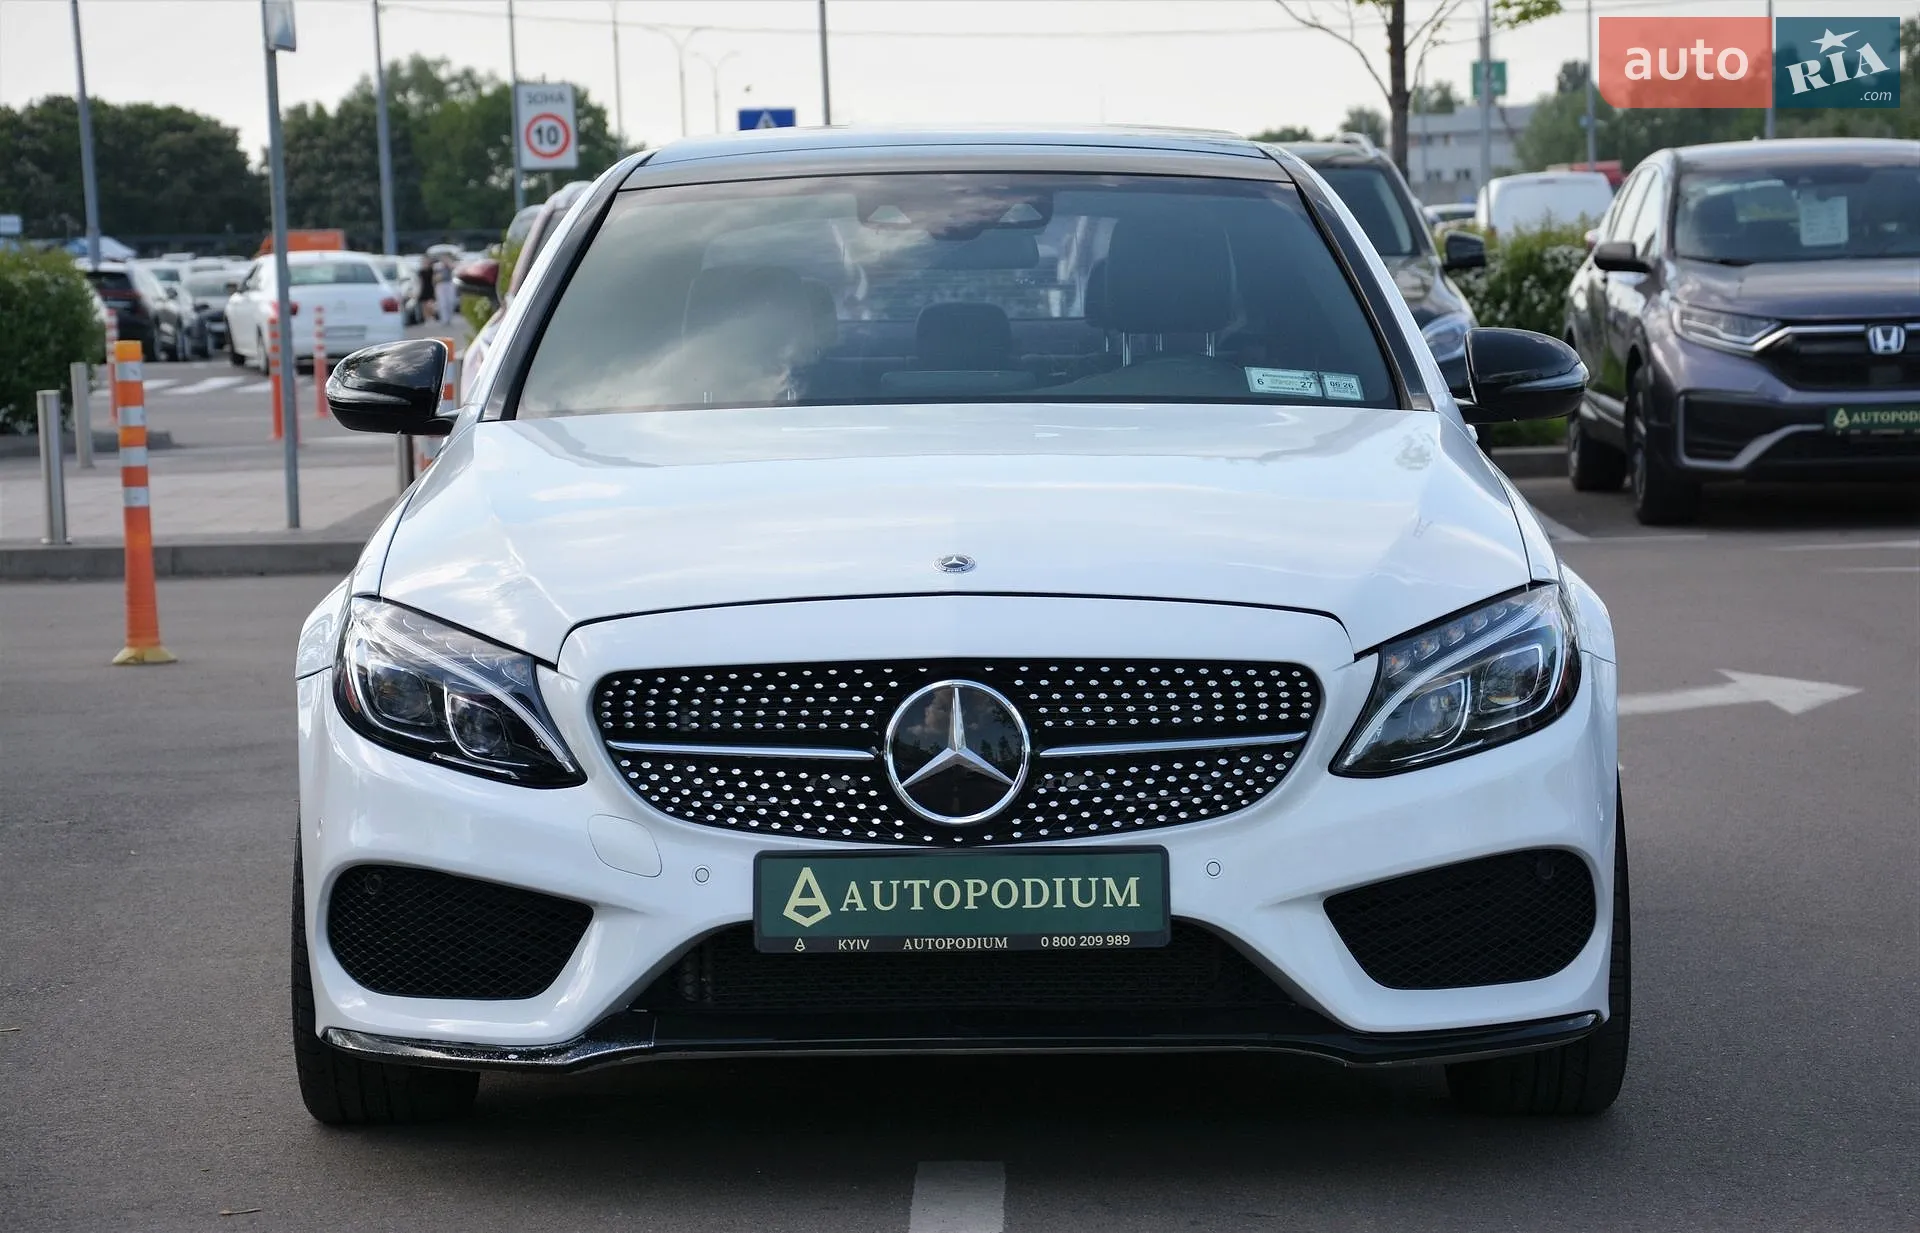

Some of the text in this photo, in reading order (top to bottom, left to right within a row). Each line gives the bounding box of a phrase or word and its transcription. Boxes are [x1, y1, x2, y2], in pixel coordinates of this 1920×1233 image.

[534, 124, 559, 146] 10
[1852, 410, 1920, 424] AUTOPOD
[840, 876, 1141, 912] AUTOPODIUM
[838, 934, 1131, 950] KYIV AUTOPODIUM 0 800 209 989
